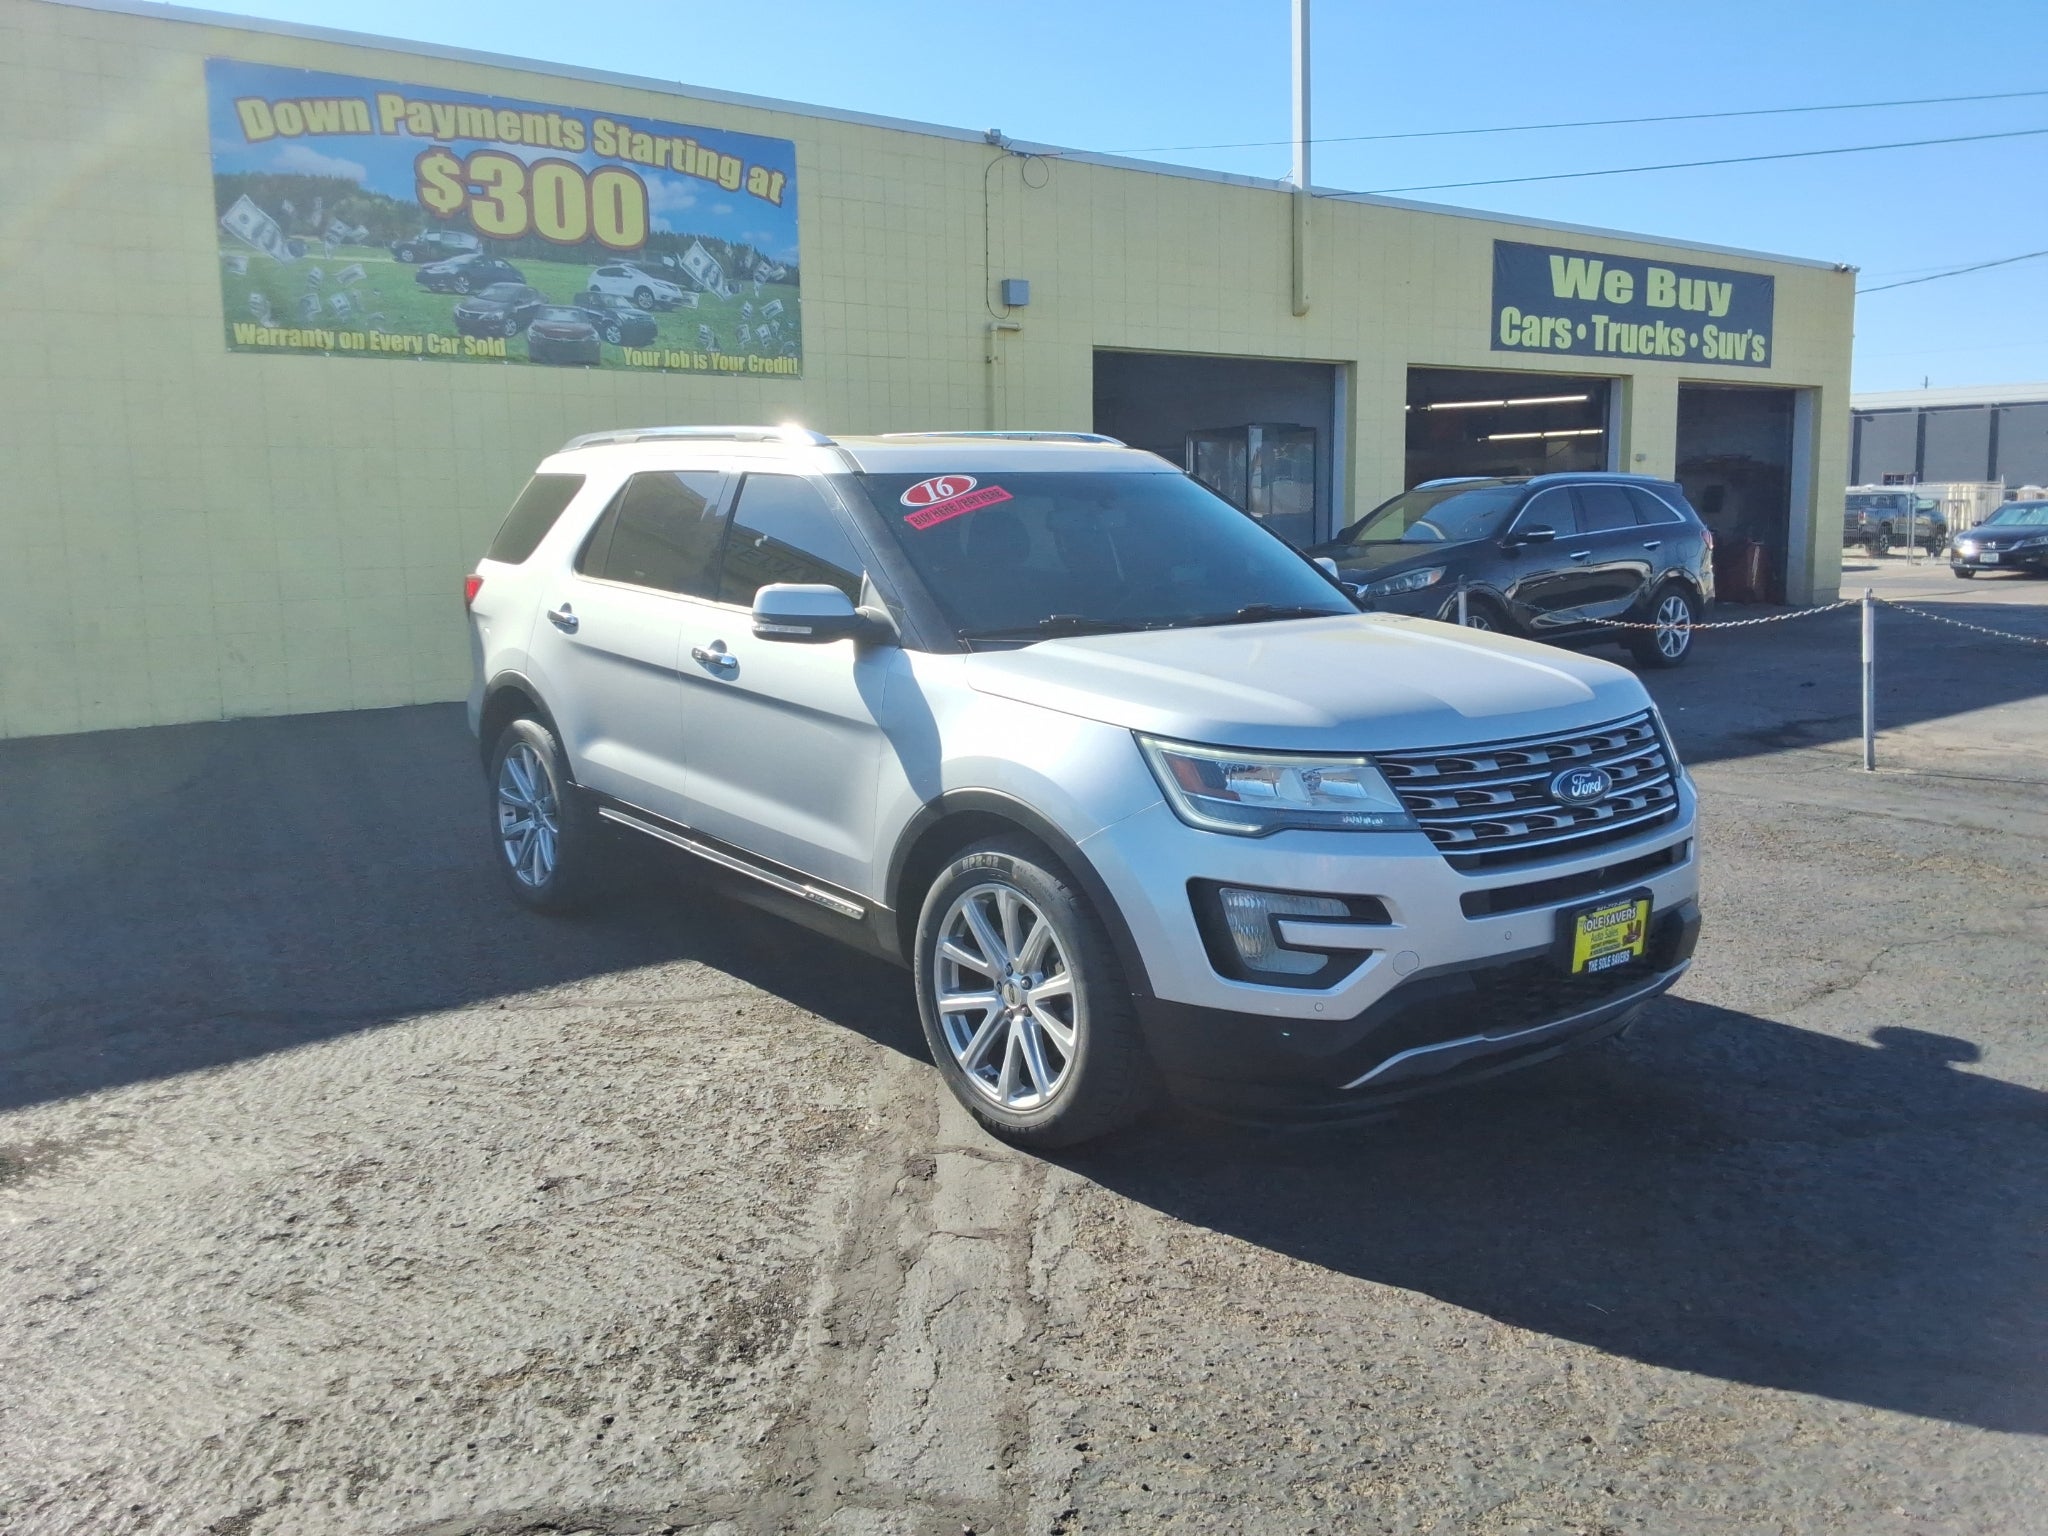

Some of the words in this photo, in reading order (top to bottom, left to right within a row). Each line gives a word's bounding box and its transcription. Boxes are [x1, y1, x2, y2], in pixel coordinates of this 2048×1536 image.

[236, 97, 372, 143] Down
[376, 92, 587, 152] Payments
[591, 117, 744, 192] Starting
[747, 164, 786, 206] at
[416, 147, 648, 249] $300
[1549, 254, 1634, 305] We
[1646, 266, 1733, 318] Buy
[233, 322, 336, 350] Warranty
[338, 331, 366, 350] on
[368, 329, 423, 355] Every
[426, 333, 462, 355] Car
[464, 336, 508, 358] Sold
[1500, 306, 1573, 350] Cars
[1591, 314, 1686, 358] Trucks
[1702, 324, 1766, 363] Suv's
[623, 347, 661, 367] Your
[664, 349, 690, 369] Job
[693, 351, 709, 370] is
[711, 352, 746, 372] Your
[748, 354, 799, 375] Credit!
[920, 477, 954, 502] 16
[1571, 772, 1603, 797] Ford
[1605, 906, 1637, 927] SAVERS
